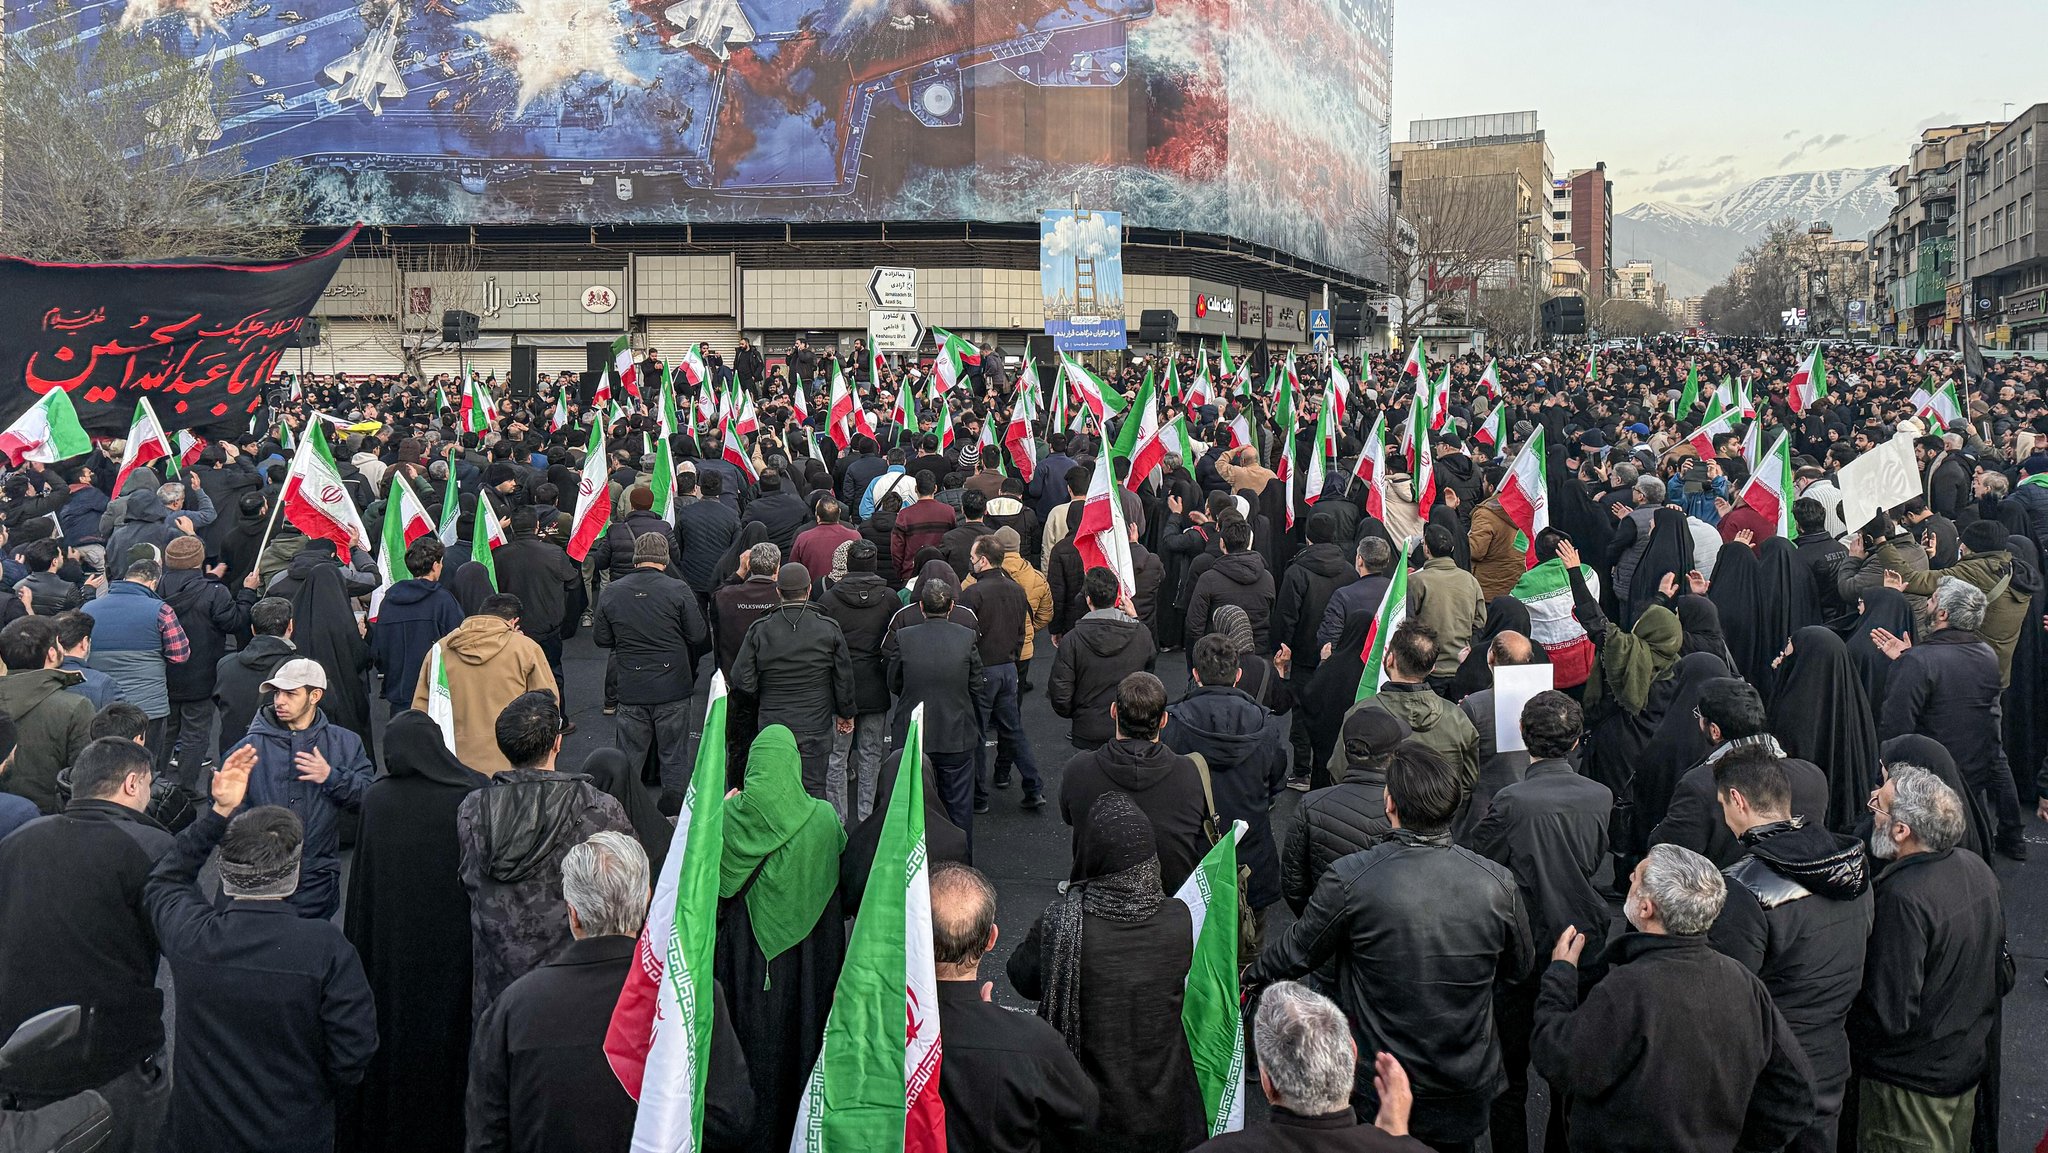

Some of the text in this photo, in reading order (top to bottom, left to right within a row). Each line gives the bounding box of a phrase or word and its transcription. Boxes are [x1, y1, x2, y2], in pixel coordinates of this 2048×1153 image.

[506, 291, 540, 308] کفش
[1207, 295, 1221, 312] ملت
[1221, 297, 1234, 318] بانک
